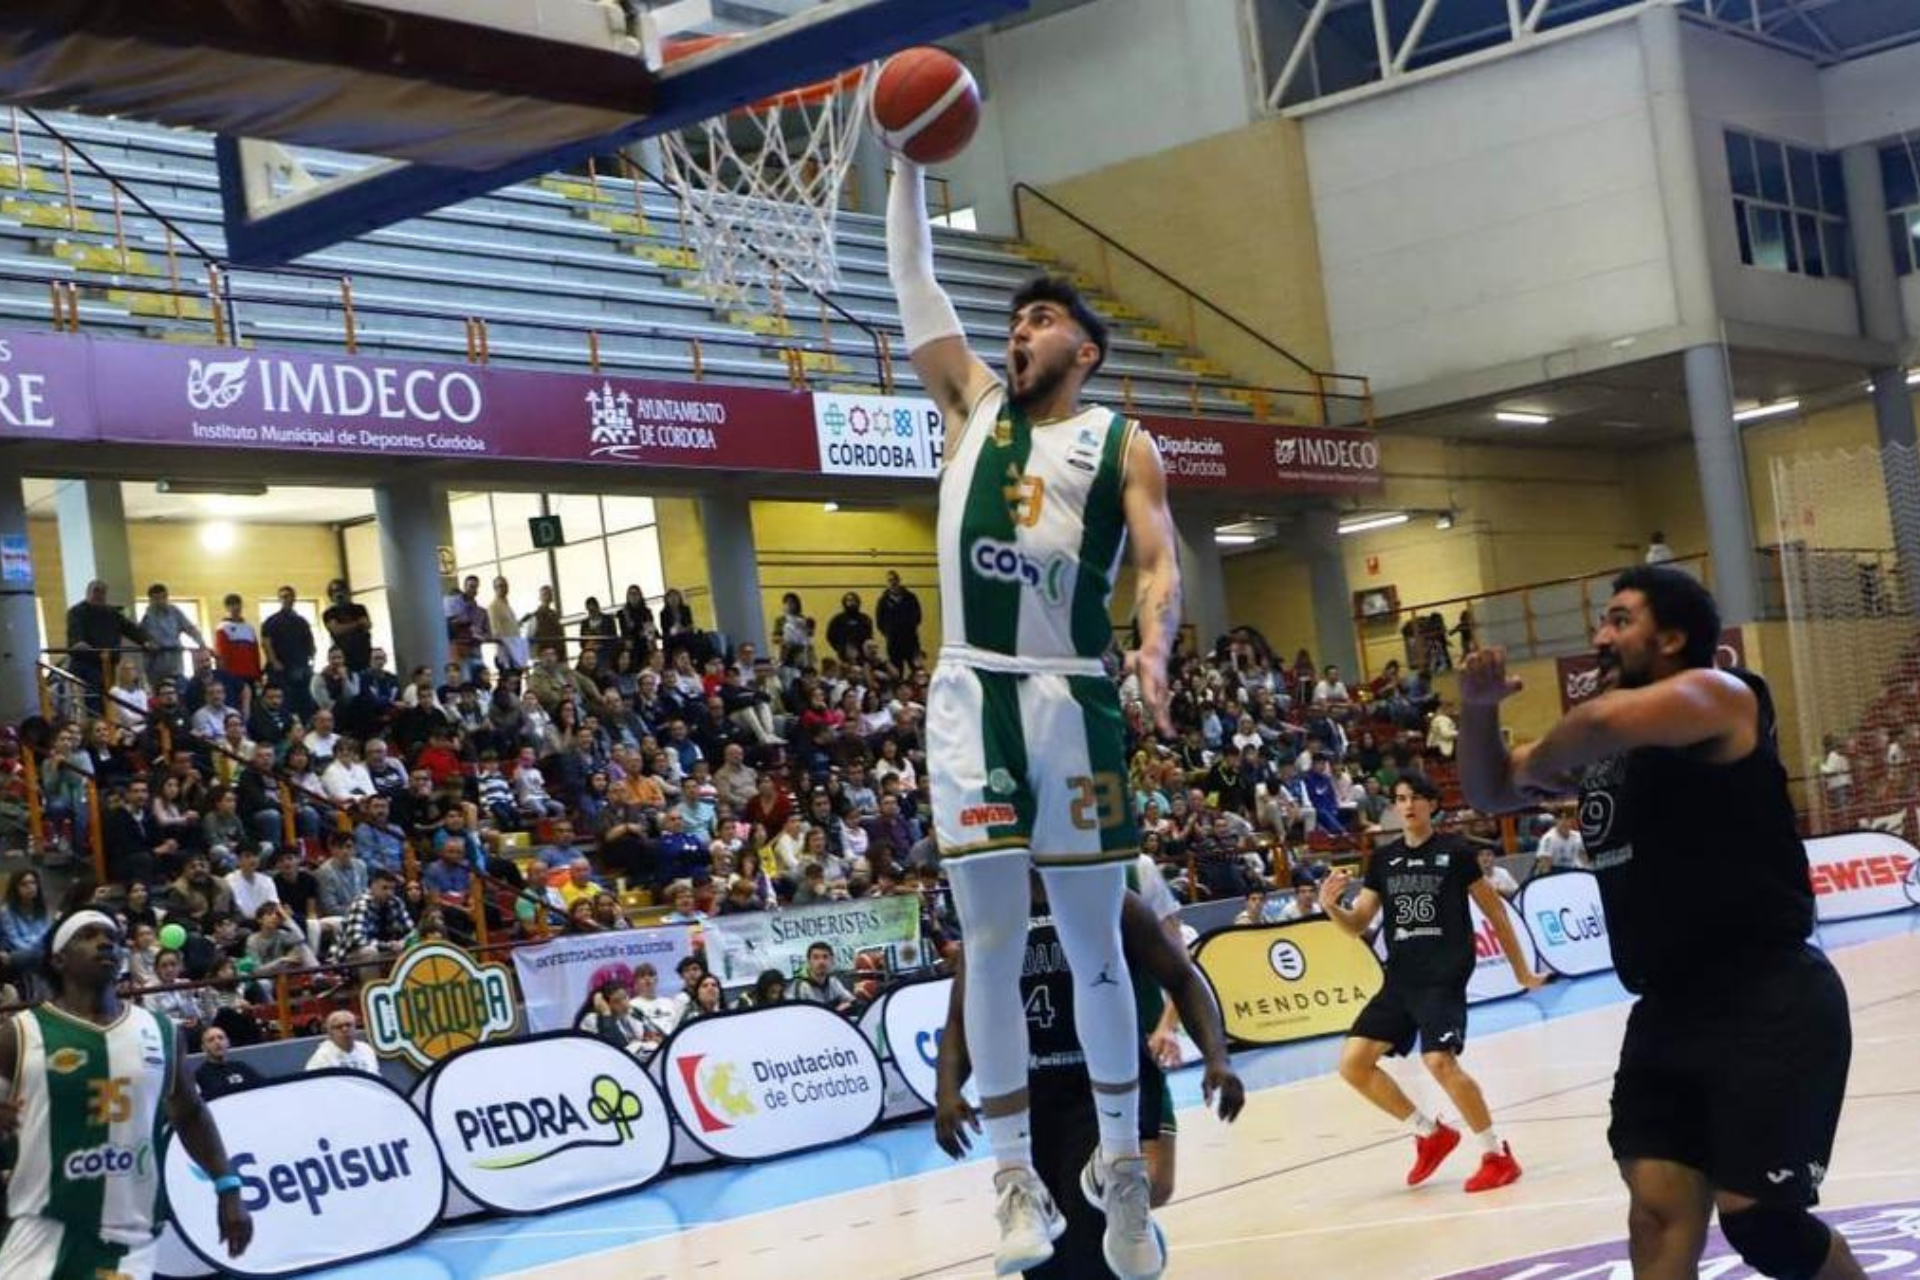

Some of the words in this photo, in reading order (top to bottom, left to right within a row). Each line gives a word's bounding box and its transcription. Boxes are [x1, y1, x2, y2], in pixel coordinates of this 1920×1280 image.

[258, 359, 482, 423] IMDECO
[637, 398, 726, 424] AYUNTAMIENTO
[192, 422, 257, 440] Instituto
[261, 425, 334, 447] Municipal
[338, 429, 356, 445] de
[360, 430, 425, 450] Deportes
[427, 432, 486, 451] Córdoba
[640, 424, 657, 446] DE
[658, 423, 718, 449] CÓRDOBA
[1158, 435, 1223, 455] Diputación
[829, 439, 916, 468] CÓRDOBA
[1179, 457, 1226, 477] Córdoba
[1299, 438, 1378, 469] IMDECO
[1066, 772, 1125, 830] 23
[1394, 894, 1435, 924] 36
[771, 910, 881, 944] SENDERISTAS
[1234, 985, 1367, 1019] MENDOZA
[752, 1046, 859, 1084] Diputación
[87, 1076, 133, 1127] 35
[764, 1087, 789, 1109] de
[791, 1073, 870, 1103] Córdoba
[69, 1147, 134, 1175] coto
[229, 1137, 412, 1215] Sepisur
